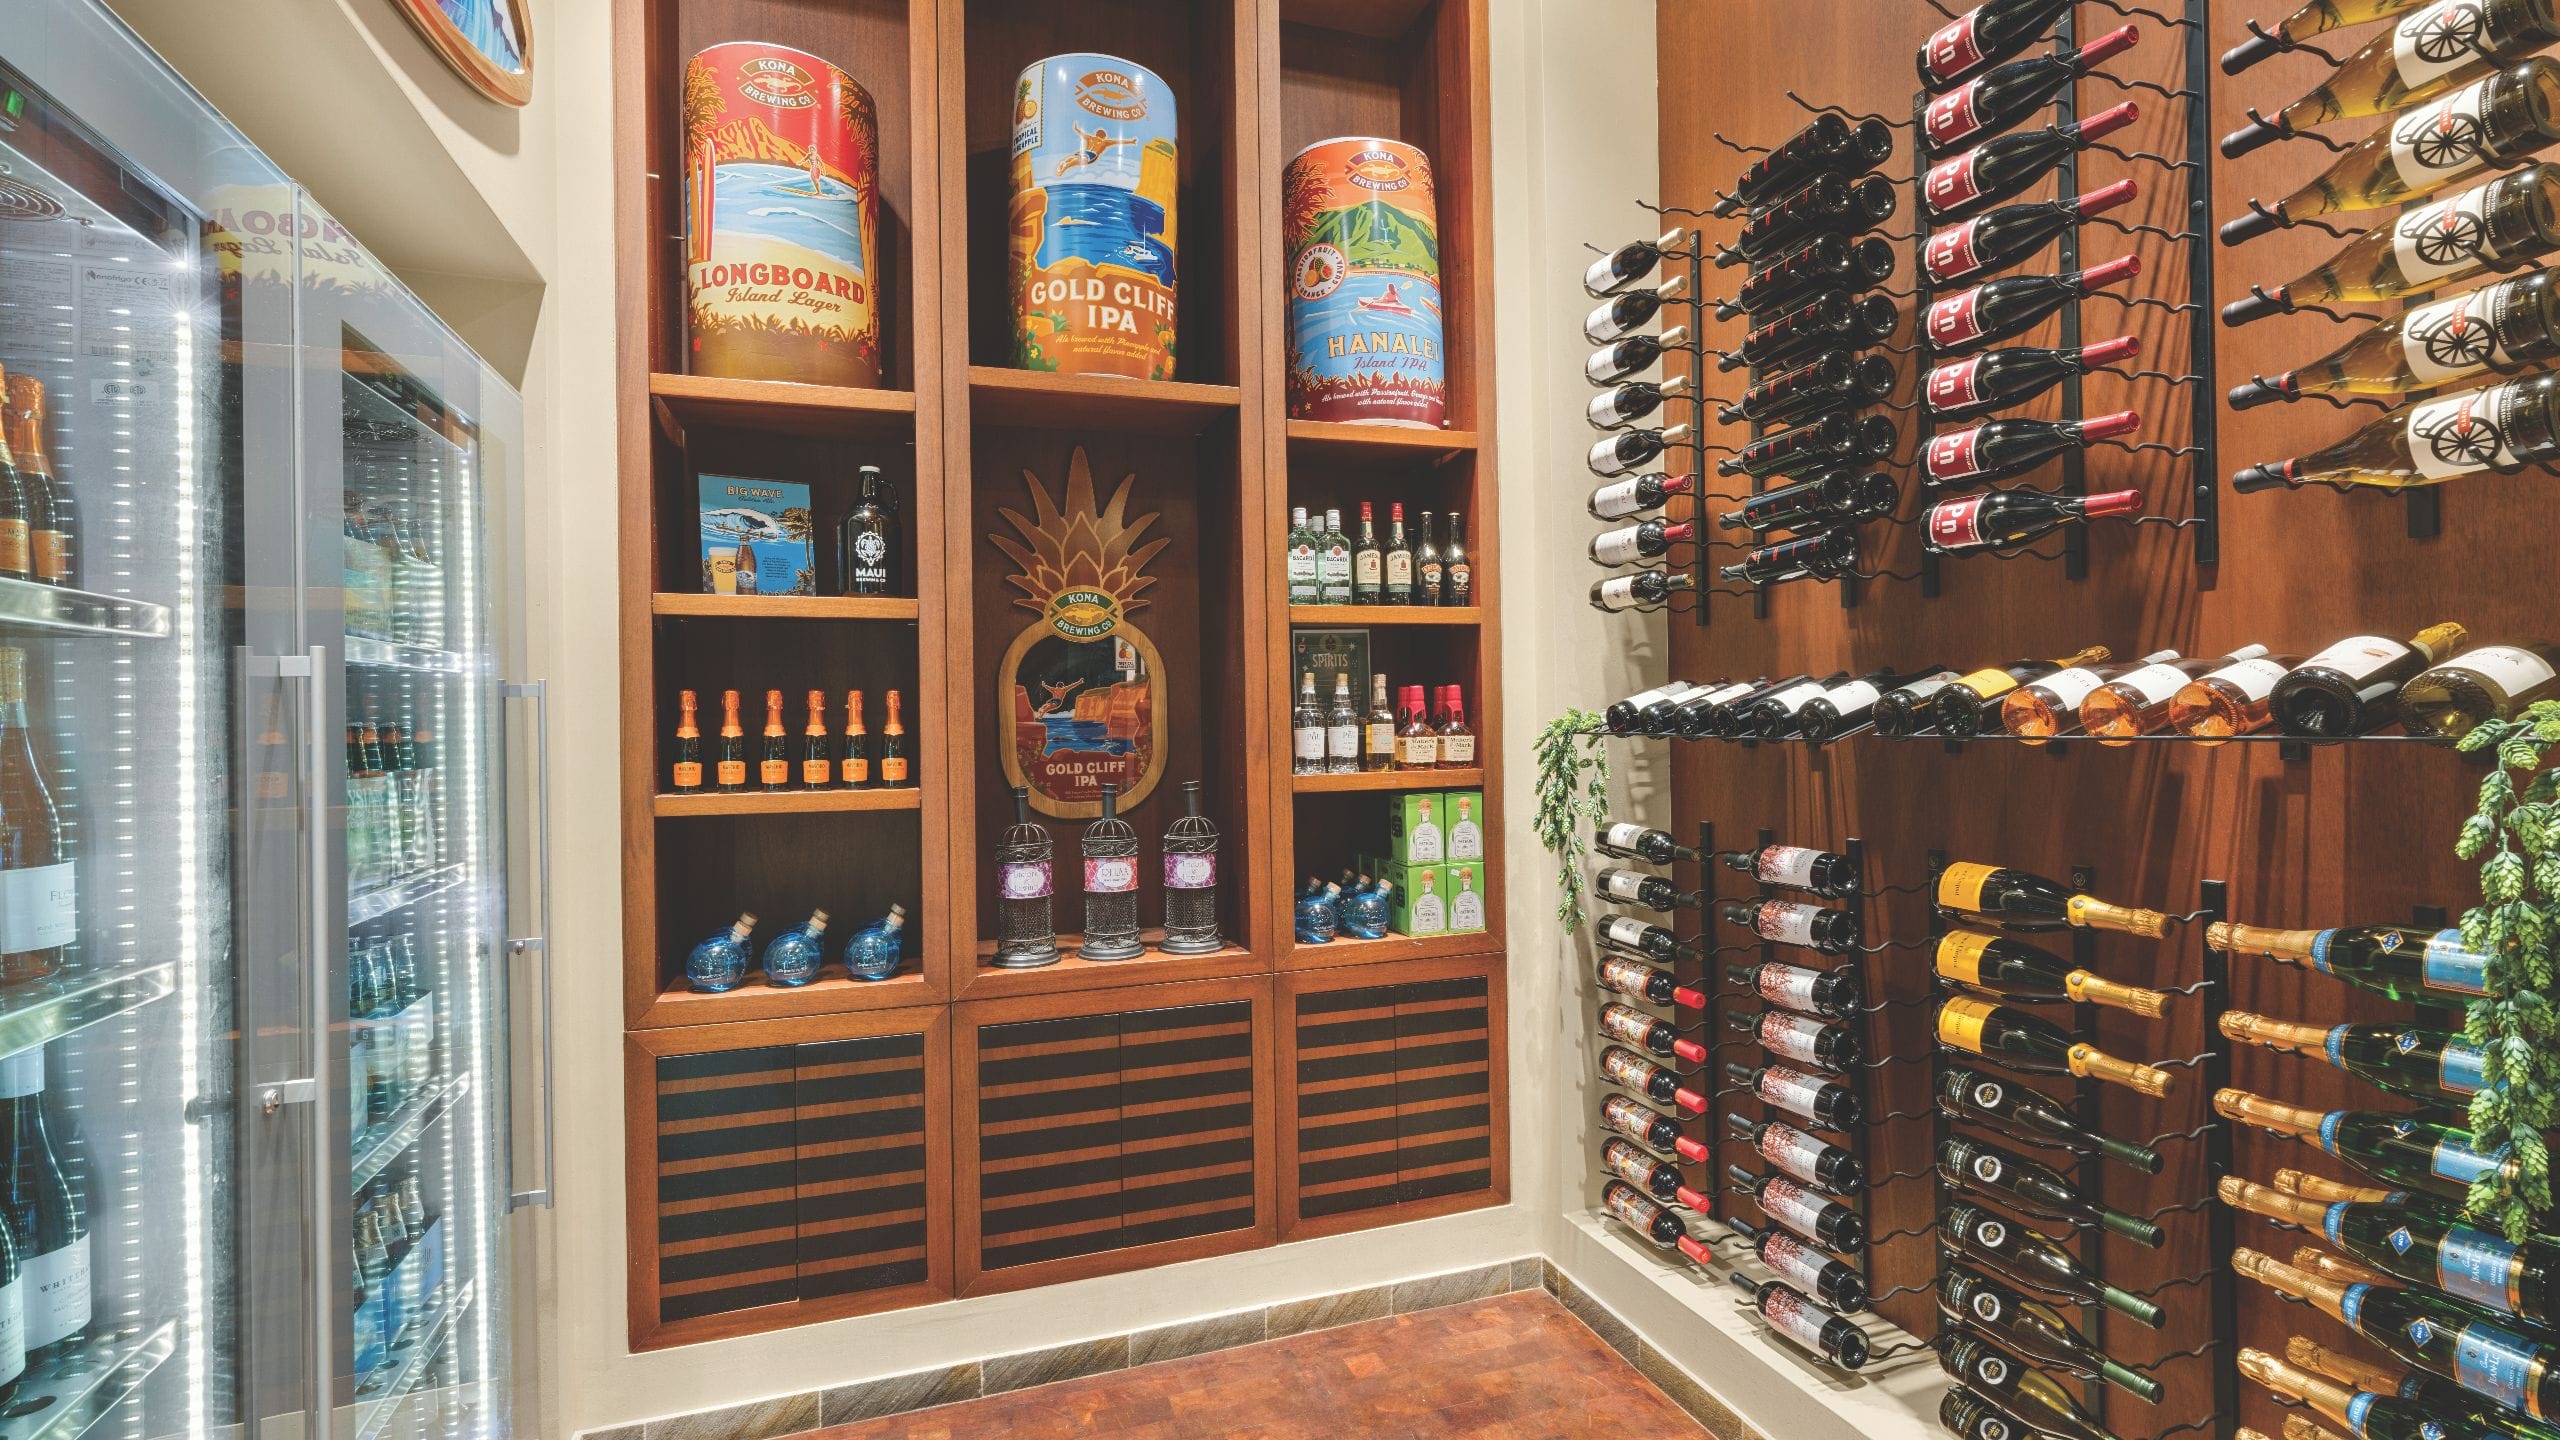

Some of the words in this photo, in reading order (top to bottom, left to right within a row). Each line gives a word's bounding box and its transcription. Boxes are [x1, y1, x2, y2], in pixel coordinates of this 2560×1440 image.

[1939, 24, 1962, 65] Pn
[758, 60, 796, 76] KONA
[1095, 73, 1129, 88] KONA
[744, 85, 797, 107] BREWING
[1082, 97, 1129, 119] BREWING
[1938, 91, 1961, 130] Pn
[1363, 151, 1395, 163] KONA
[1353, 175, 1397, 191] BREWING
[1938, 159, 1961, 196] Pn
[1938, 230, 1961, 266] Pn
[700, 262, 866, 305] LONGBOARD
[725, 286, 784, 303] Island
[787, 290, 842, 314] Lager
[1031, 278, 1105, 305] GOLD
[1113, 282, 1175, 321] CLIFF
[1088, 304, 1139, 335] IPA
[1939, 299, 1963, 332] Pn
[1327, 332, 1439, 362] HANALEI
[1352, 355, 1397, 369] Island
[1401, 355, 1428, 371] IPA
[1939, 363, 1963, 395] Pn
[1939, 432, 1967, 465] Pn
[727, 485, 748, 497] BIG
[751, 487, 783, 498] WAVE
[1941, 503, 1968, 534] Pn
[855, 568, 886, 578] MAUI
[1069, 593, 1099, 604] KONA
[1056, 619, 1100, 635] BREWING
[1313, 653, 1348, 668] SPIRITS
[1046, 763, 1082, 775] GOLD
[1086, 761, 1125, 774] CLIFF
[1075, 775, 1098, 786] IPA
